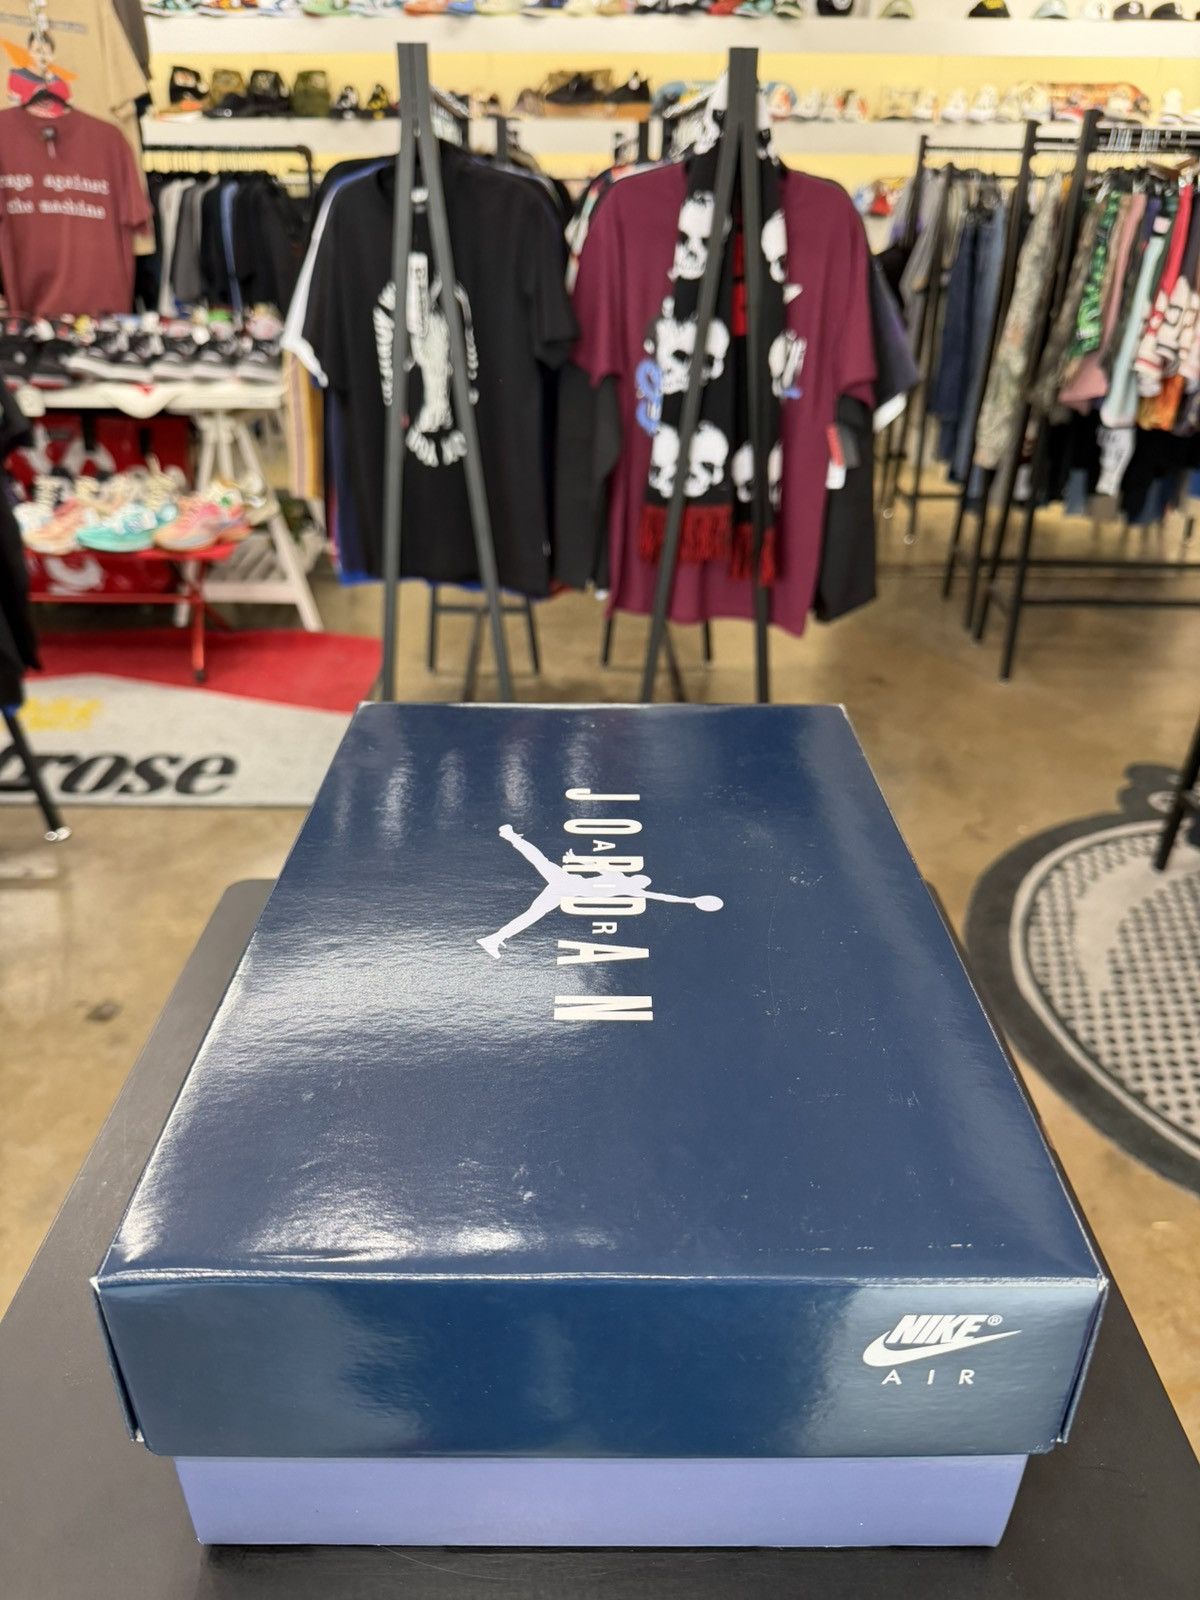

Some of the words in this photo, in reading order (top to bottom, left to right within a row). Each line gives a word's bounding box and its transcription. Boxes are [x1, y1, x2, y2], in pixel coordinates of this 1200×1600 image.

[43, 173, 110, 196] against
[39, 197, 106, 220] machine
[553, 788, 654, 1021] JORDAN
[880, 1368, 976, 1386] AIR
